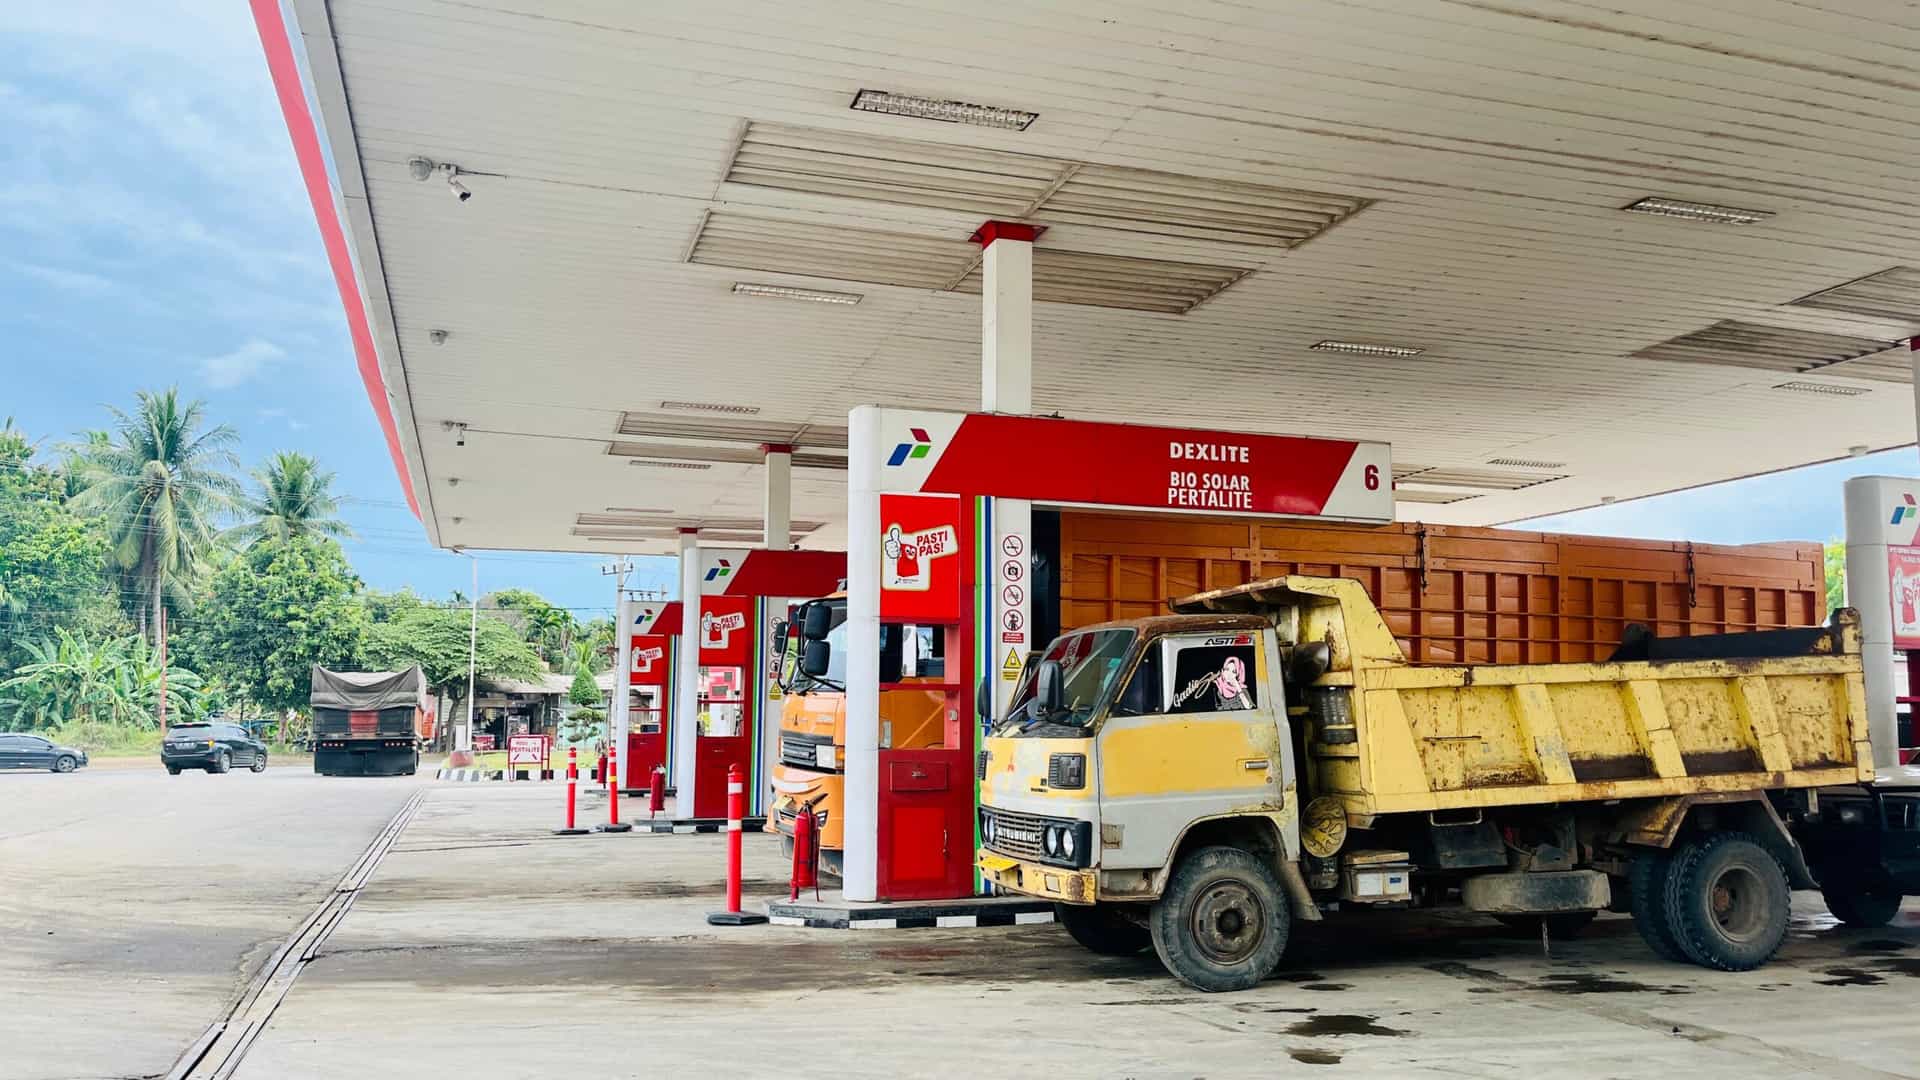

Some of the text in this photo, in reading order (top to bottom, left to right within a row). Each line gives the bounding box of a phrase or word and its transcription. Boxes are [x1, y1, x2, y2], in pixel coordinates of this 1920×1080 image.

[1169, 442, 1249, 463] DEXLITE
[1170, 471, 1250, 491] BIO SOLAR
[1364, 464, 1379, 491] 6
[1168, 487, 1253, 509] PERTALITE
[916, 530, 948, 546] PASTI
[919, 542, 944, 557] PAS!
